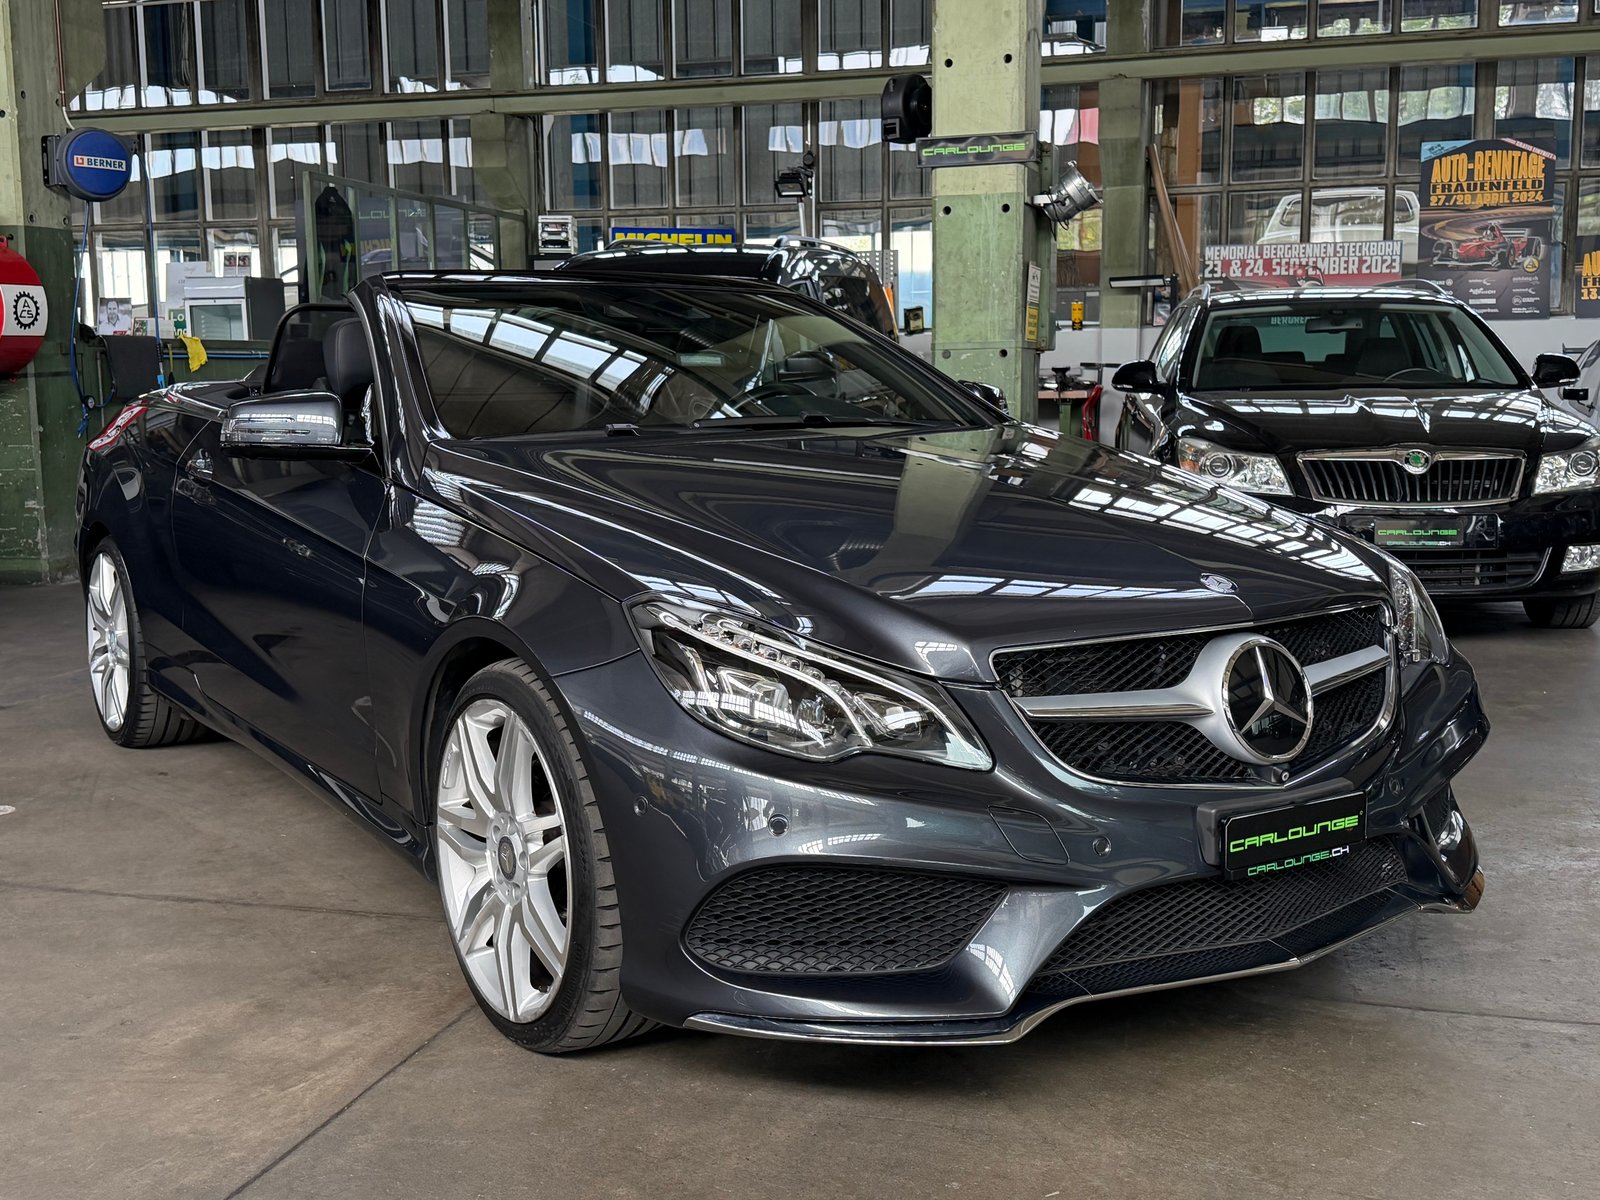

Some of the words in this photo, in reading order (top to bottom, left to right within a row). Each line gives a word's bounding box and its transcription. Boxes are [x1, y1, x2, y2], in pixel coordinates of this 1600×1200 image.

[922, 143, 1026, 156] CARLOUNGE
[86, 157, 124, 170] BERNER
[1431, 150, 1545, 183] AUTO-RENNTAGE
[1431, 179, 1544, 194] FRAUENFELD
[1476, 192, 1509, 206] APRIL
[1511, 191, 1543, 203] 2024
[1205, 245, 1261, 261] MEMORIAL
[1263, 242, 1335, 259] BERGRENNEN
[1336, 240, 1401, 257] STECKBORN
[1204, 260, 1227, 278] 23.
[1229, 259, 1242, 277] &
[1245, 259, 1269, 277] 24.
[1272, 257, 1359, 276] SEPTEMBER
[1361, 255, 1400, 274] 2023
[1230, 814, 1359, 853] CARLOUNGE
[1247, 845, 1350, 876] CARLOUNGE.CH
